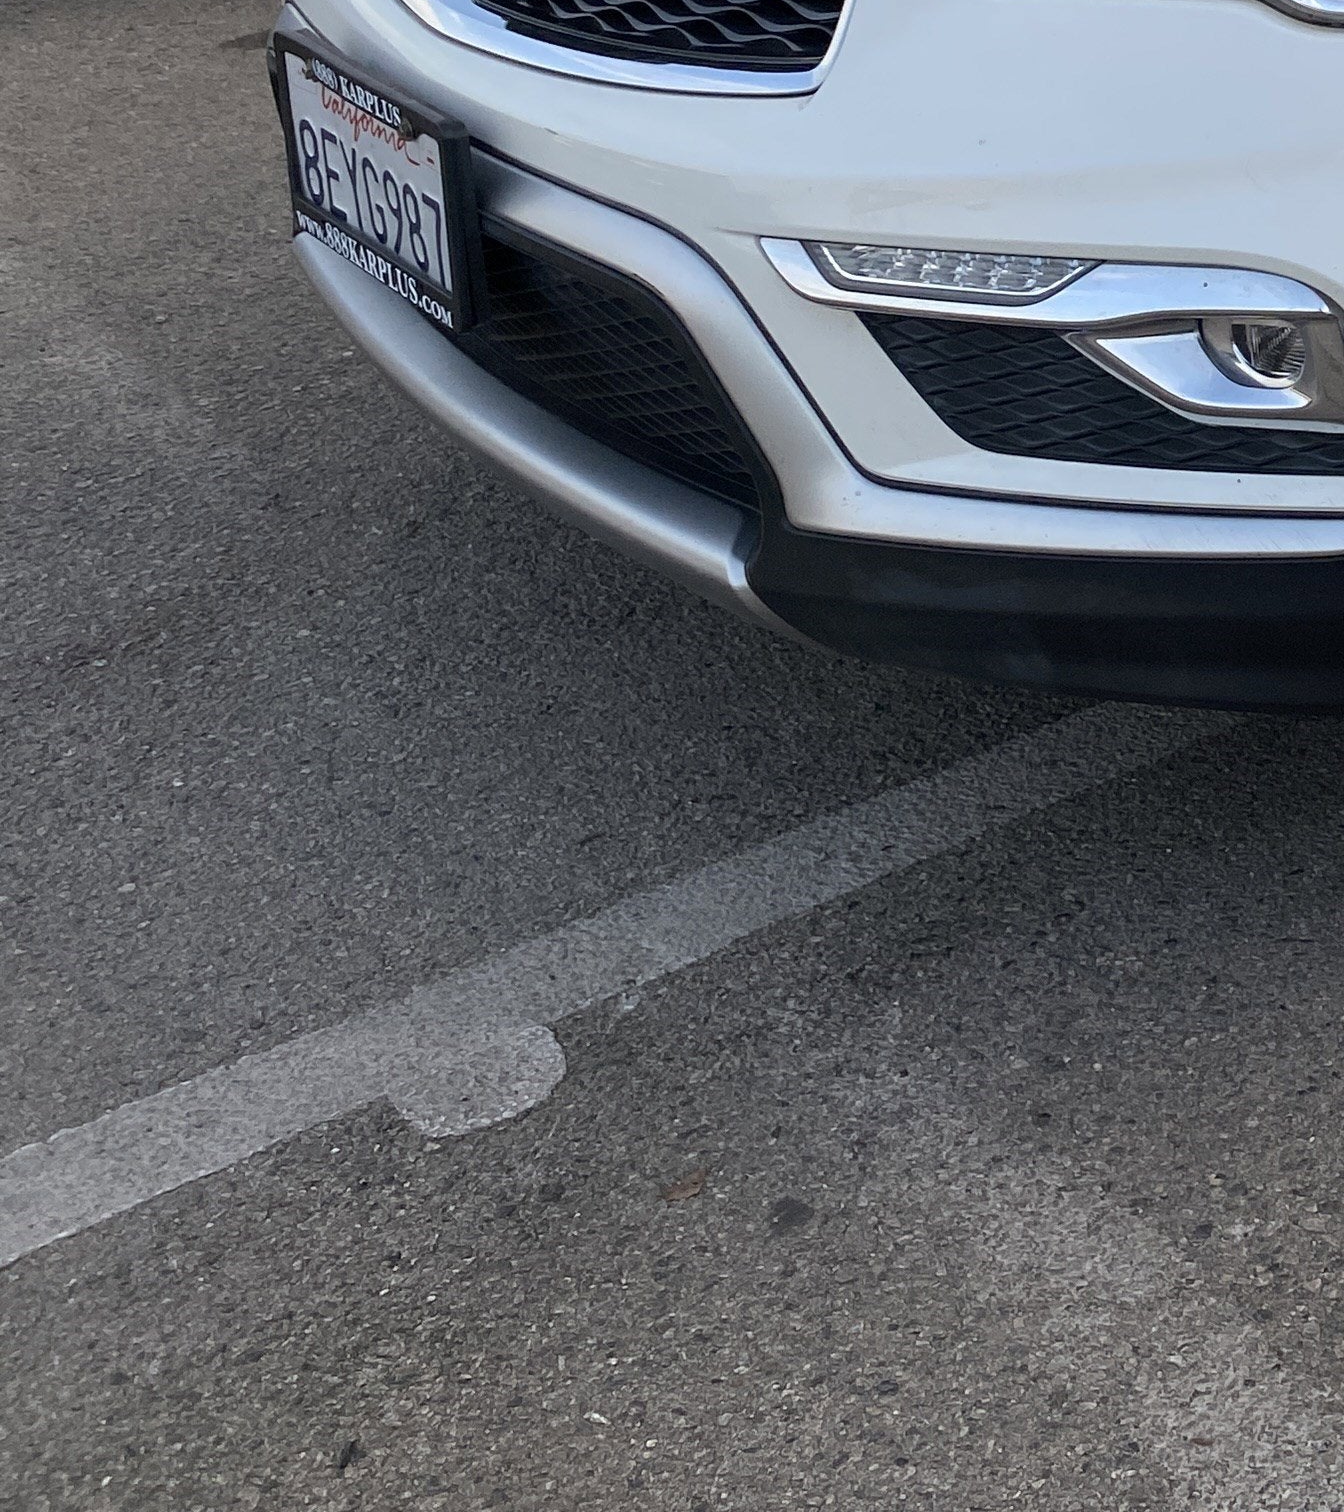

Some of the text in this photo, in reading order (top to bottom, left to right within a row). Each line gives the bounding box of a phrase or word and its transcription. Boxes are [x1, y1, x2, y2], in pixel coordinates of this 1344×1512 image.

[311, 57, 402, 127] (888) KARPLUS
[299, 119, 446, 290] 8EYG987
